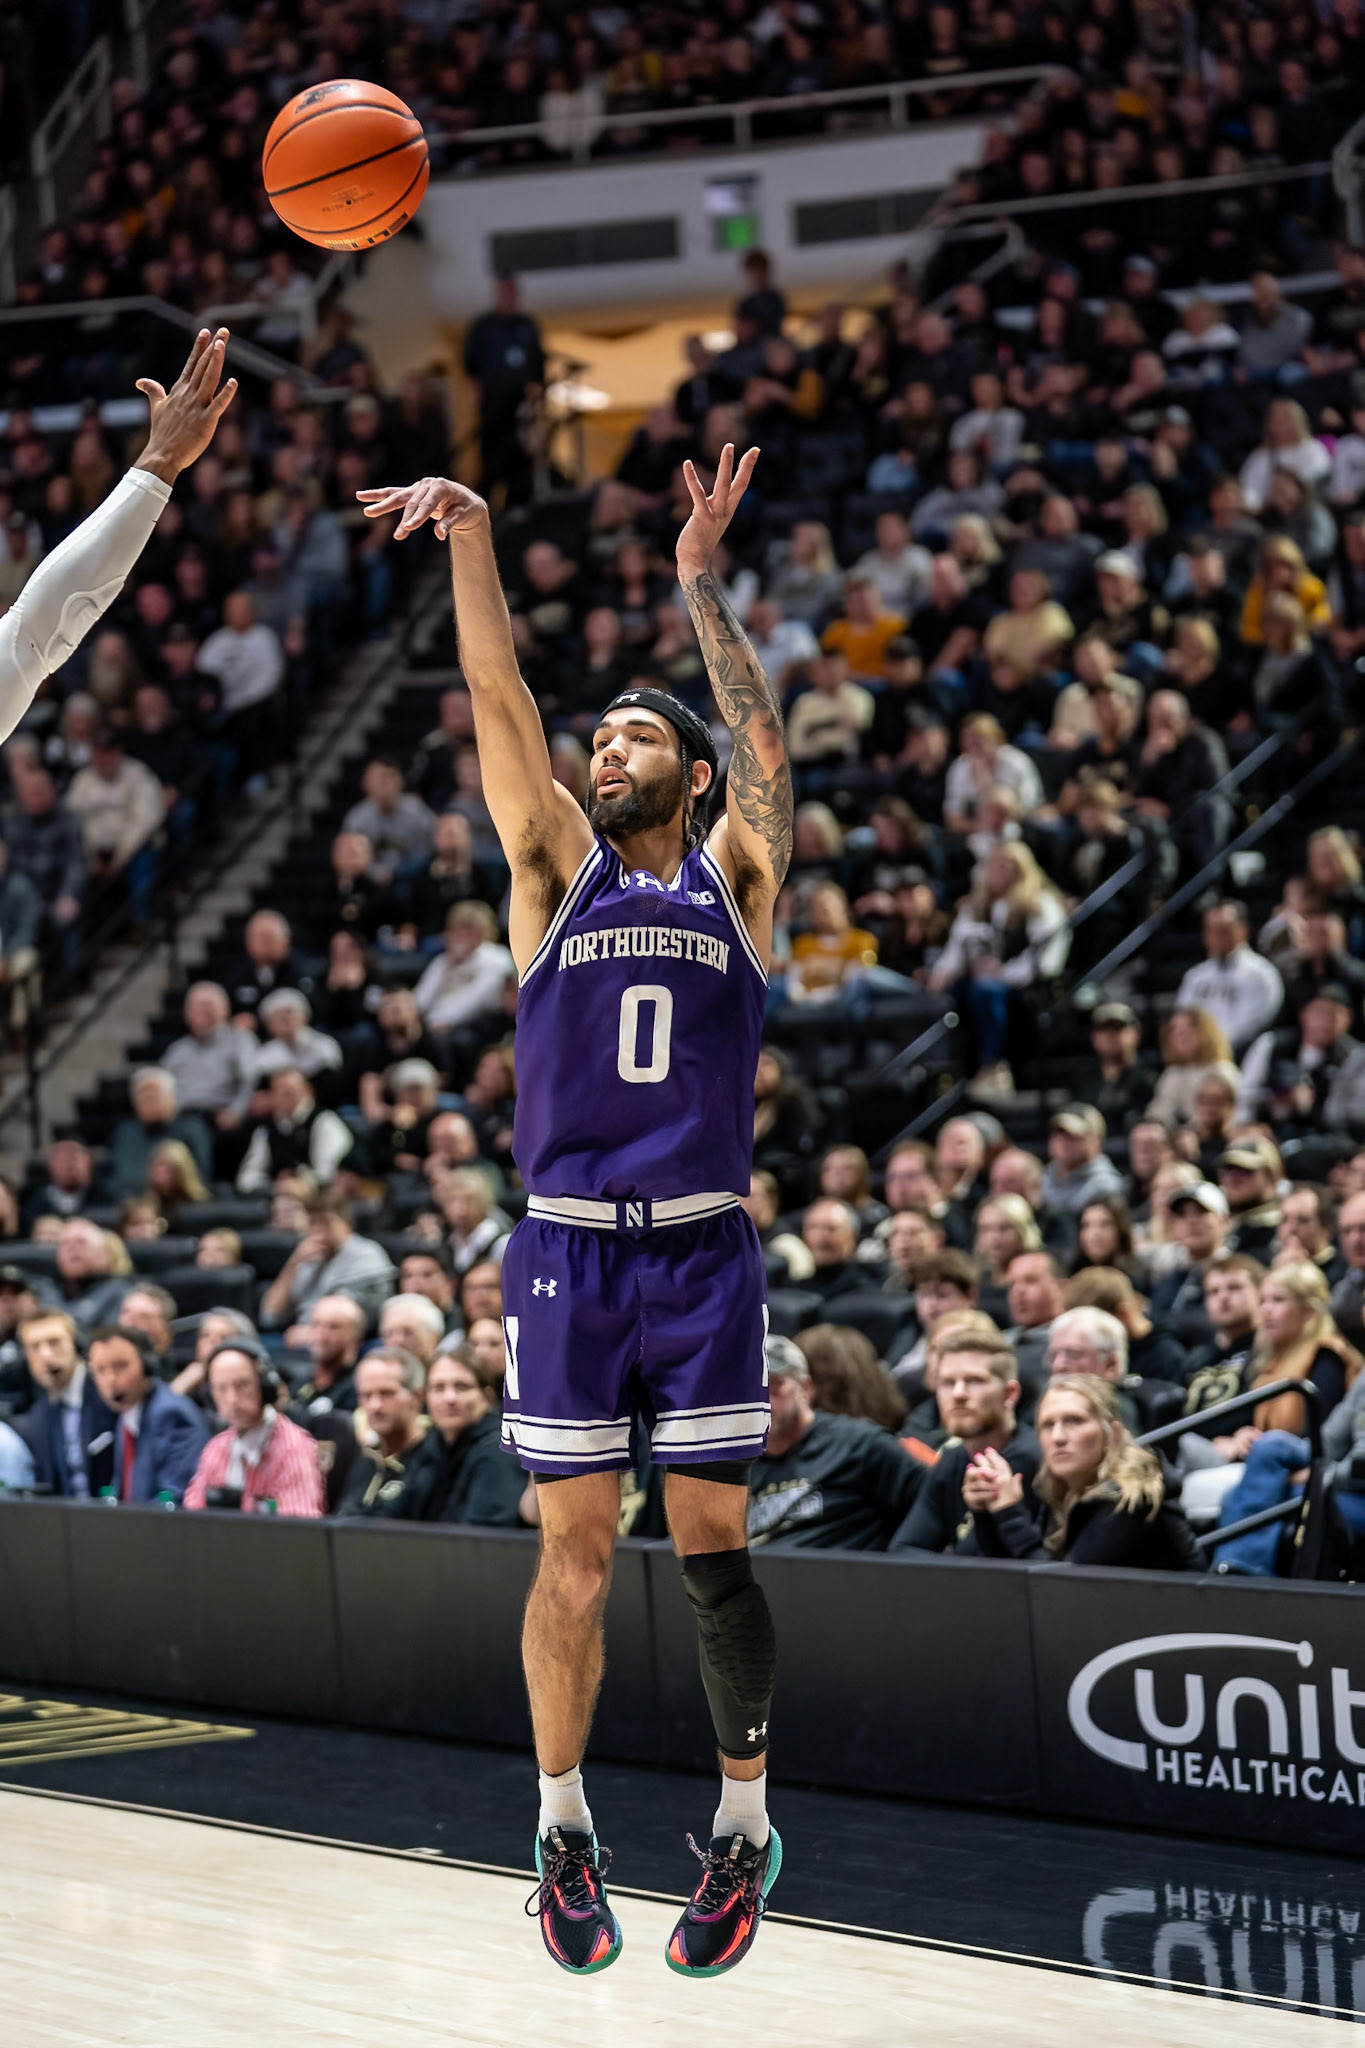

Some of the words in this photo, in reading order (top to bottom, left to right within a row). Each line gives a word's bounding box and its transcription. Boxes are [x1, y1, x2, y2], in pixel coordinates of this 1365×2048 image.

[558, 926, 730, 975] NORTHWESTERN
[617, 984, 674, 1084] 0
[625, 1201, 644, 1228] N
